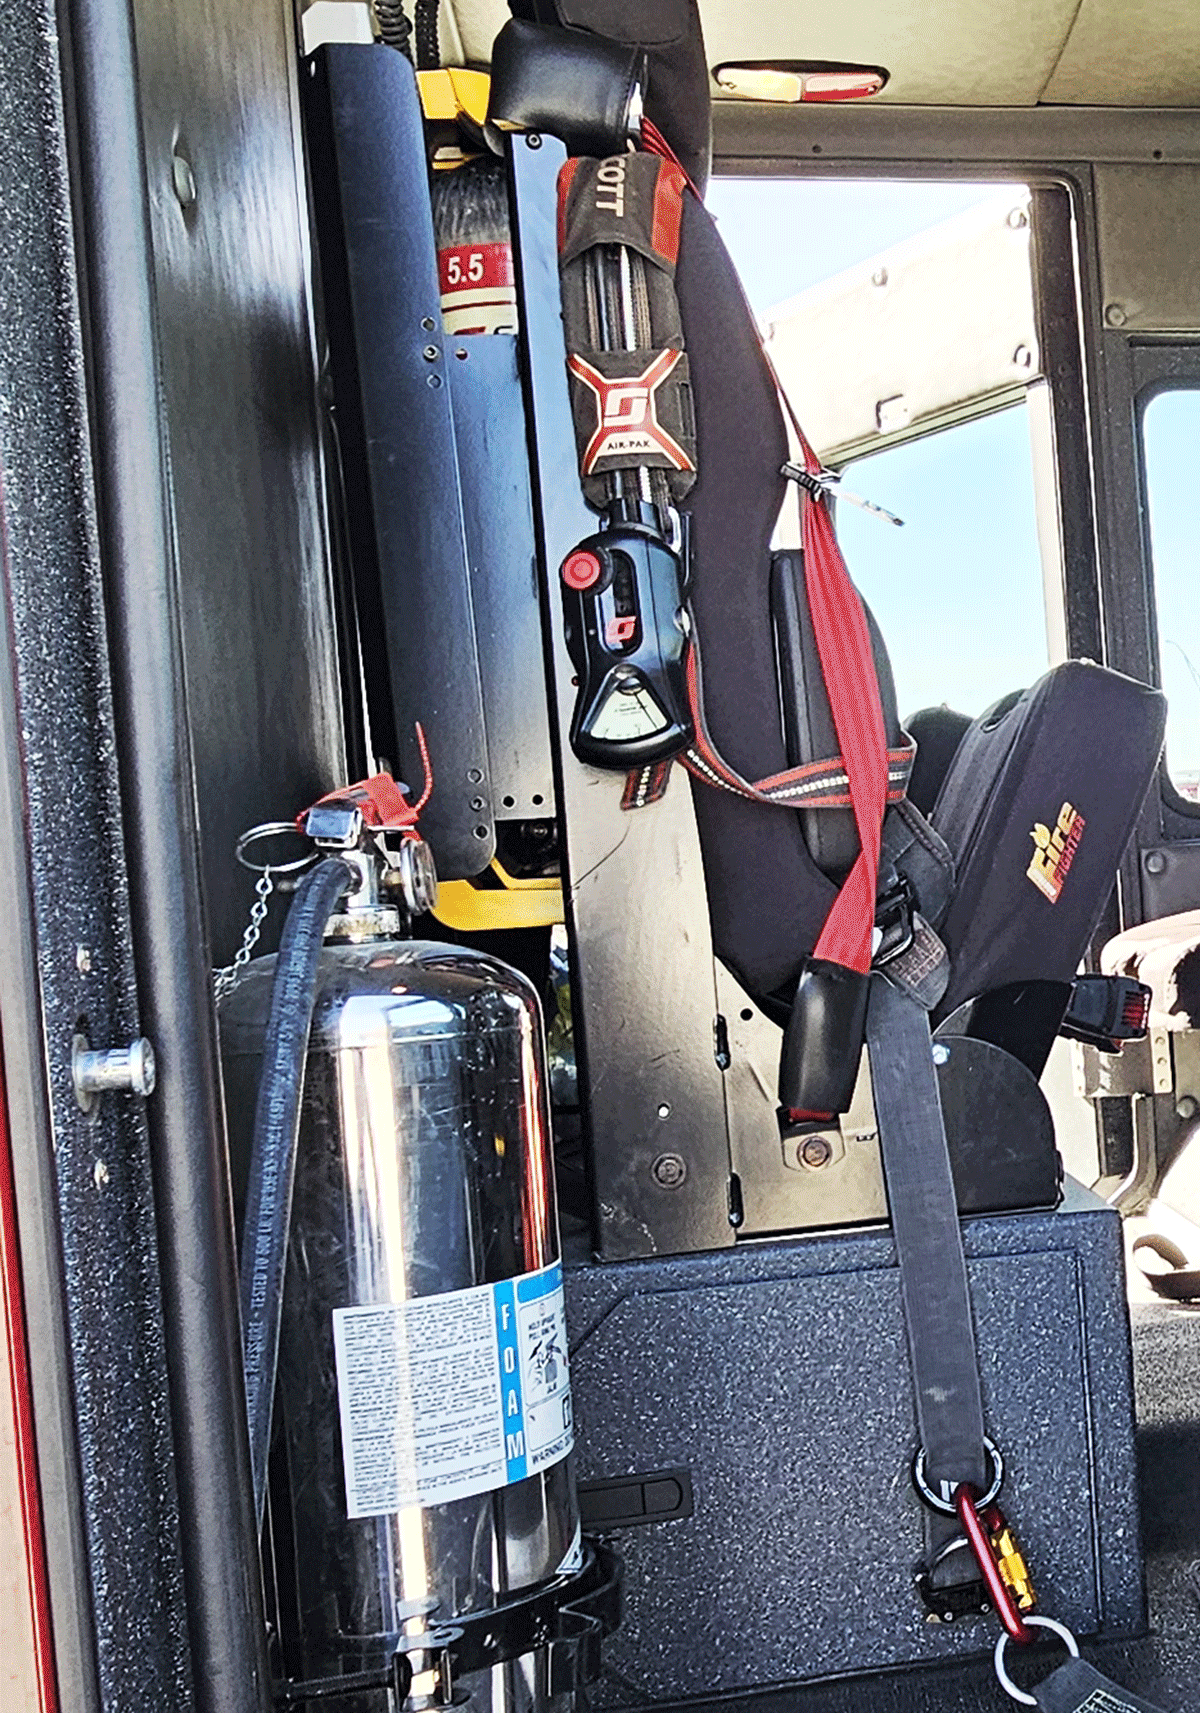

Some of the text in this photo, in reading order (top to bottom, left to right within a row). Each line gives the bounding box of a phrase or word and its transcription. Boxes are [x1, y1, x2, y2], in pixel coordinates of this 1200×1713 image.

[447, 253, 484, 285] 5.5
[607, 440, 651, 450] AIR-PAK
[1053, 815, 1086, 884] FIGHTER
[250, 1273, 268, 1309] TESTED
[502, 1303, 525, 1460] FOAM
